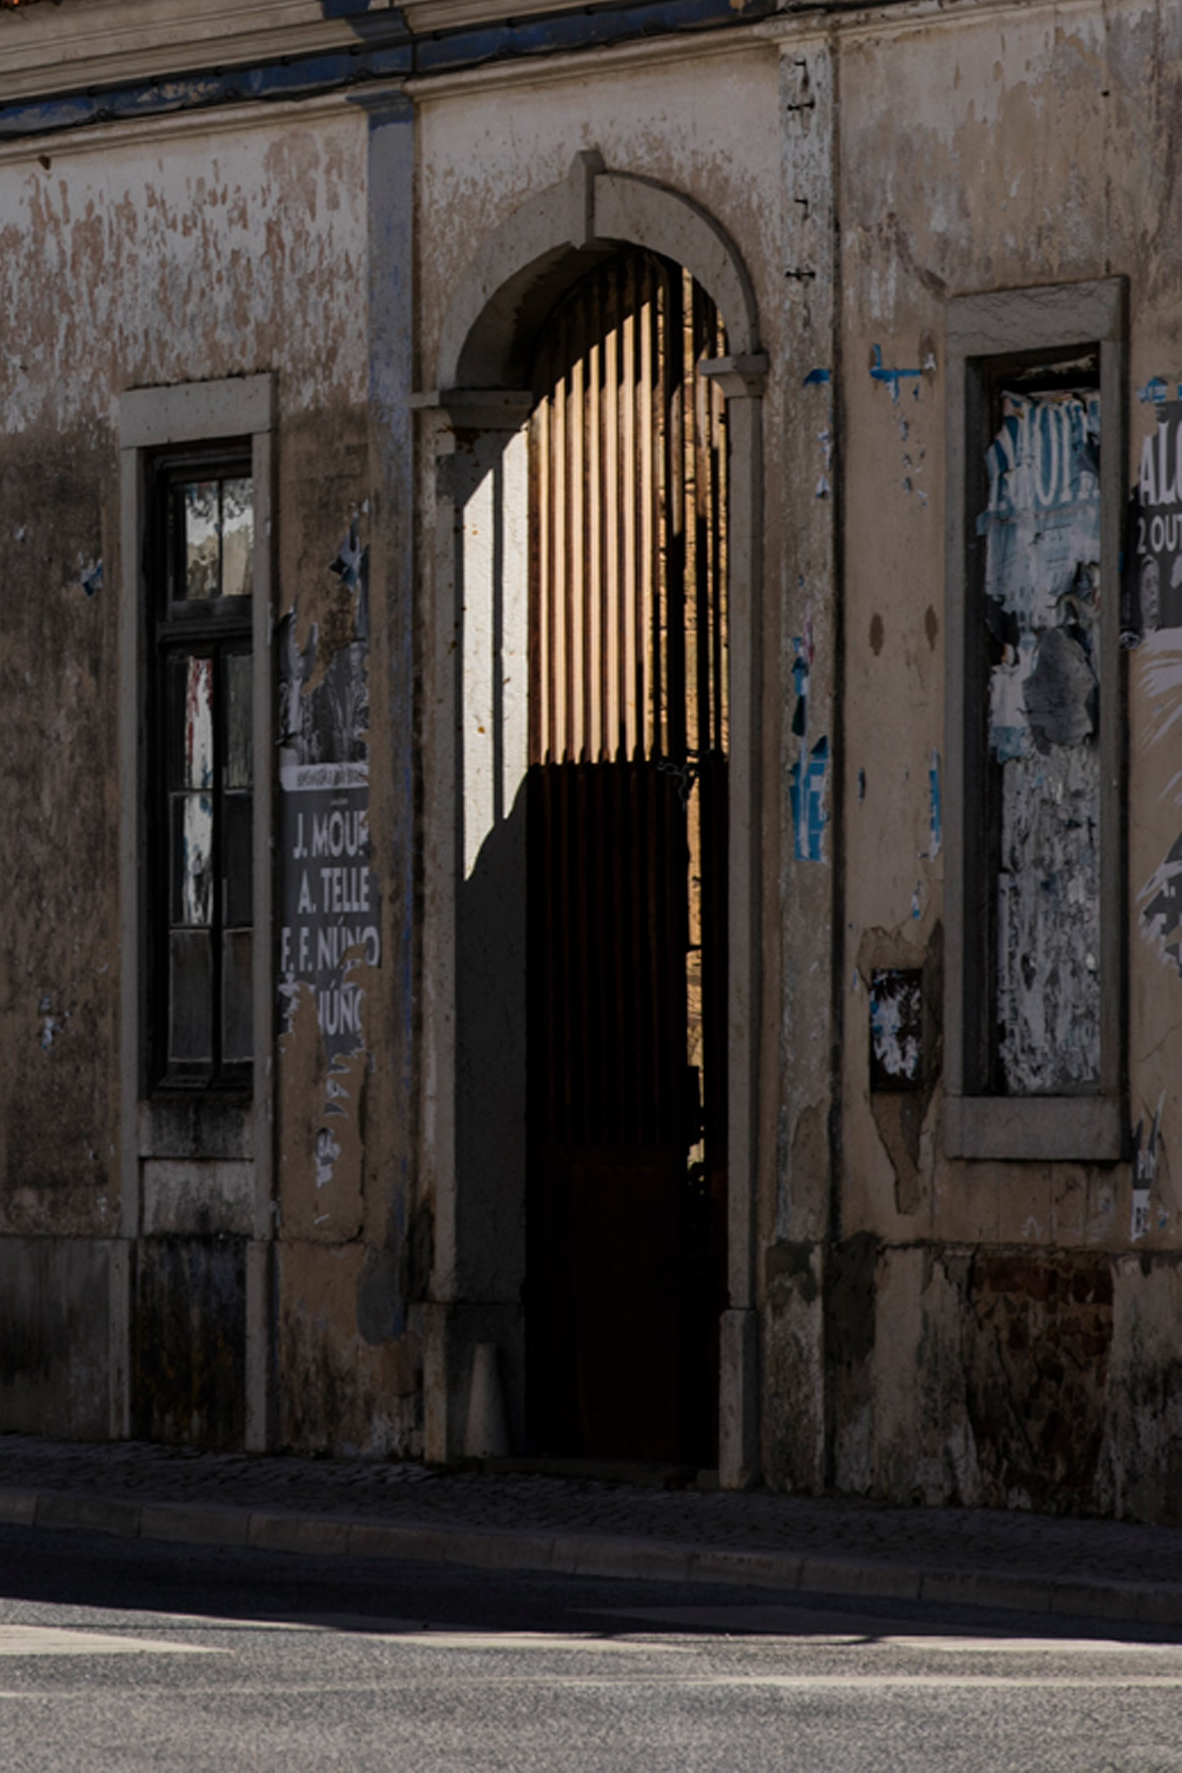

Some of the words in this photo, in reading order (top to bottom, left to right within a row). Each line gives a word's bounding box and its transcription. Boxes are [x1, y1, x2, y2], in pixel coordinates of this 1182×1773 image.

[1137, 517, 1147, 554] 2
[293, 812, 308, 860] J.
[297, 869, 317, 914] A.
[320, 867, 370, 913] TELLE
[281, 927, 294, 972] F.
[299, 927, 313, 972] F.
